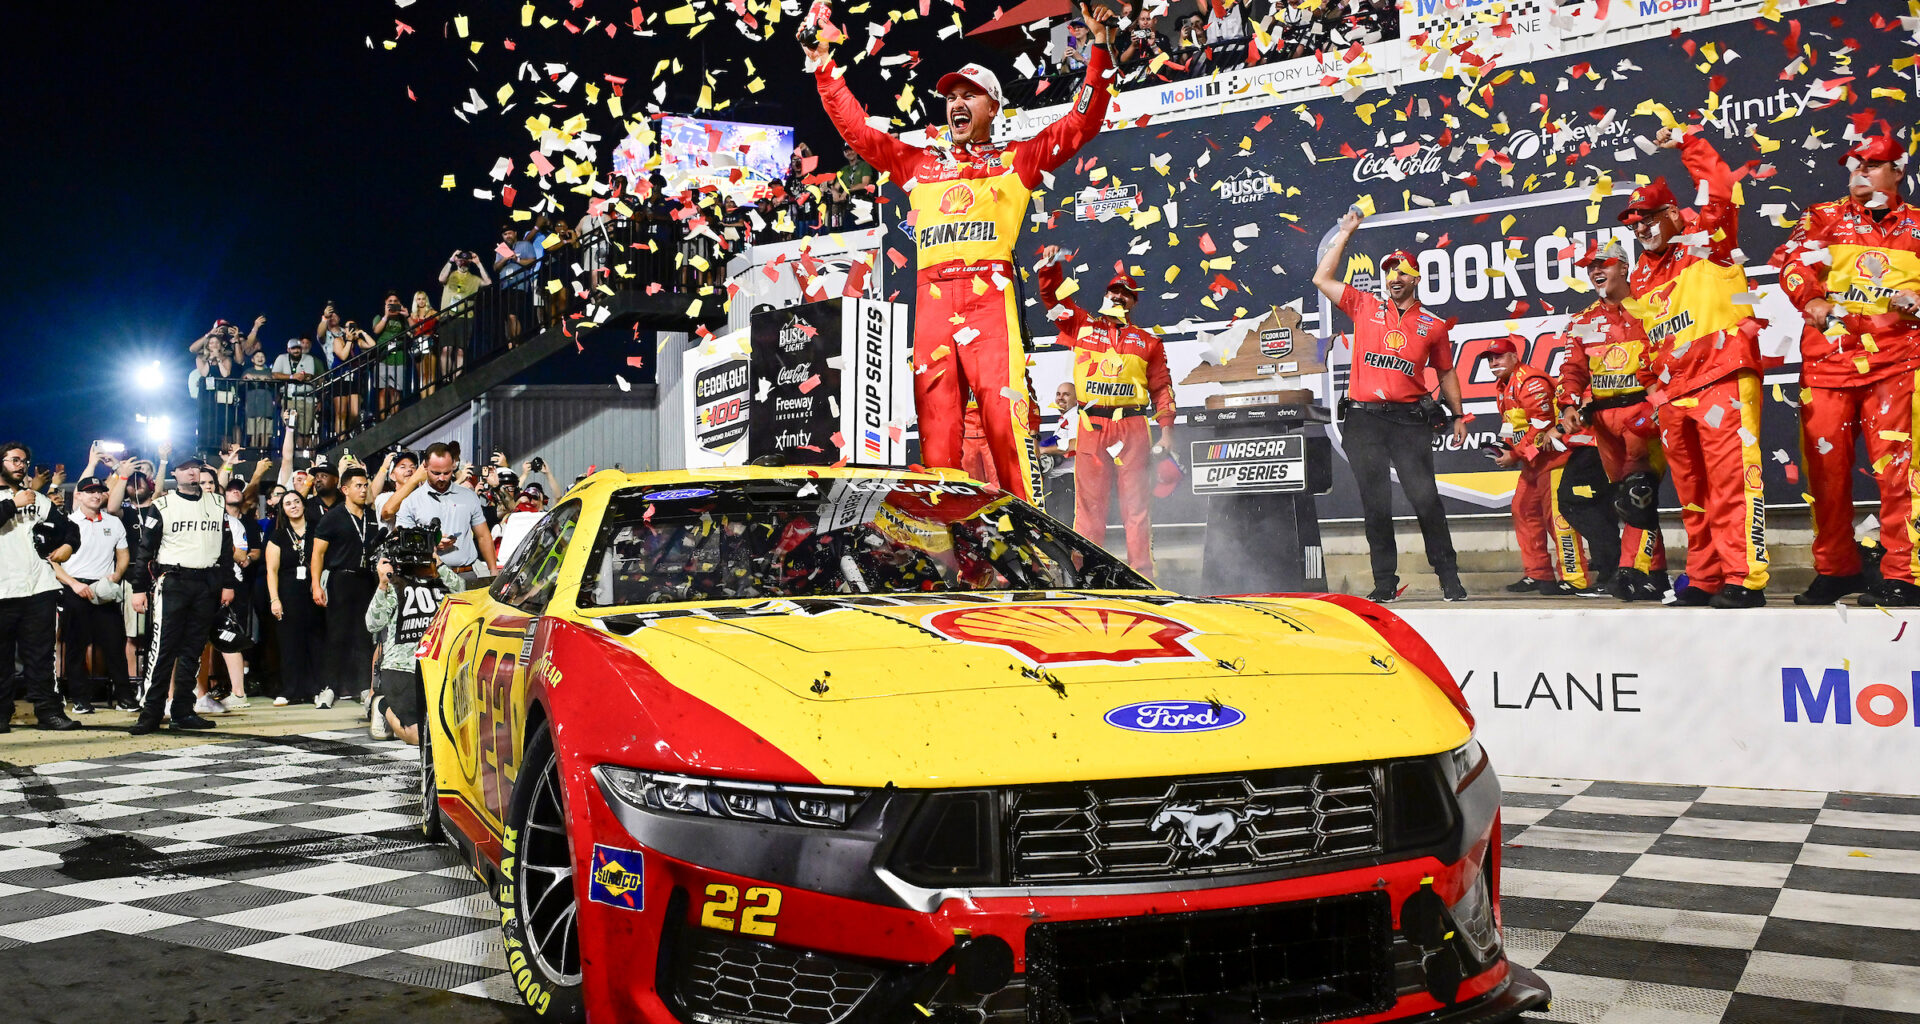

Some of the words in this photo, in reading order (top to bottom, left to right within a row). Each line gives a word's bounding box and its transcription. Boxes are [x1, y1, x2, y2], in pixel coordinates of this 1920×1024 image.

[1160, 85, 1203, 105] Mobil
[1245, 68, 1302, 87] VICTORY
[1306, 60, 1343, 77] LANE
[1698, 85, 1812, 129] xfinity
[1541, 118, 1628, 145] Feay
[1542, 137, 1629, 157] INSUANCE
[1353, 143, 1442, 182] CocCola
[1096, 188, 1129, 201] SCAR
[1220, 177, 1275, 199] BUSCH
[1232, 193, 1263, 205] LIGHT
[920, 221, 998, 250] PENNZOIL
[1380, 237, 1527, 305] OOK
[784, 342, 804, 352] LIGHT
[867, 306, 883, 383] SERIES
[1364, 351, 1415, 376] PENNZOIL
[704, 371, 728, 398] COOK
[729, 365, 747, 389] OUT
[1086, 380, 1135, 397] PENNZOIL
[706, 398, 741, 427] 400
[775, 410, 813, 421] INSURANCE
[776, 396, 814, 412] Freeway
[866, 389, 881, 429] CUP
[775, 429, 812, 451] xfinity
[1226, 440, 1287, 458] NASCAR
[1207, 467, 1236, 482] CUP
[1237, 465, 1289, 481] SERIES
[847, 482, 977, 496] LOGANO
[1751, 496, 1769, 564] PENNZOIL
[1561, 534, 1577, 574] PENNZOIL
[1493, 670, 1641, 713] LANE
[1136, 704, 1220, 728] Ford
[597, 868, 641, 891] SUNOCO
[701, 882, 783, 938] 22
